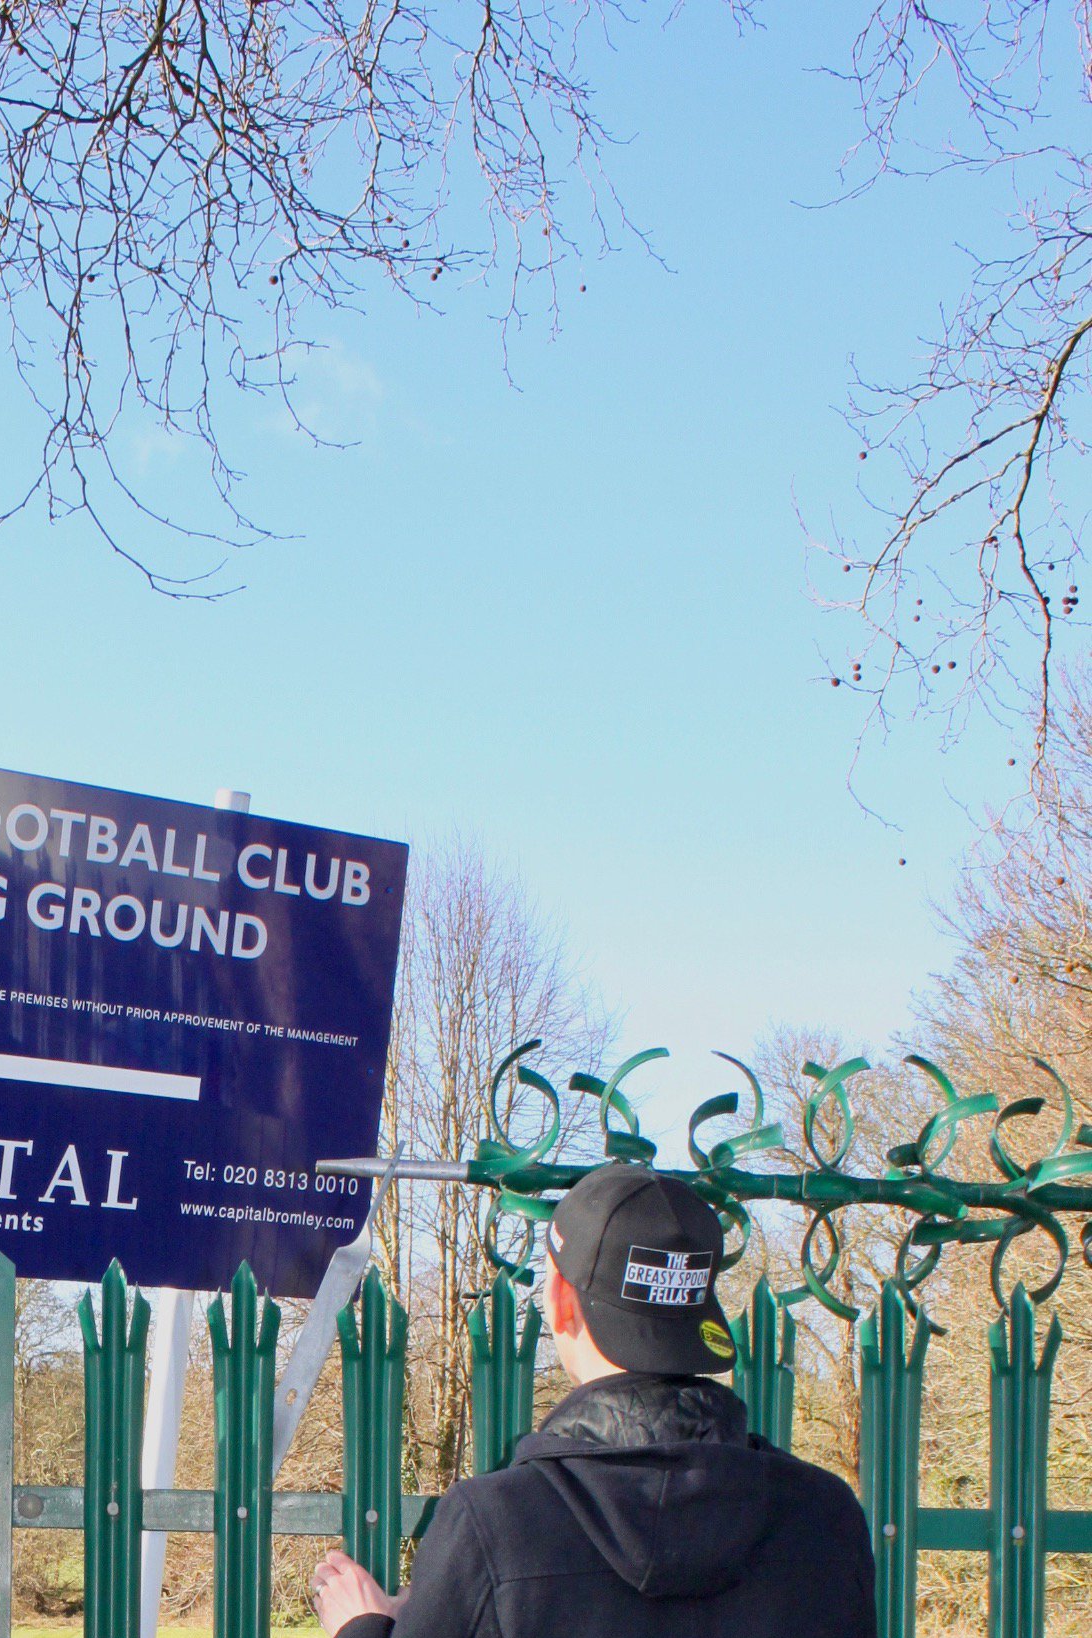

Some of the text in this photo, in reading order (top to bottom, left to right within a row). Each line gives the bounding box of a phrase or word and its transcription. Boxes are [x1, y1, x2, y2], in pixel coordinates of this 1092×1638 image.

[237, 844, 371, 906] CLUB
[27, 882, 268, 959] GROUND
[10, 991, 68, 1009] PREMISES
[72, 999, 123, 1016] WITHOUT
[126, 1006, 160, 1021] PRIOR
[163, 1010, 243, 1032] APPROVEMENT
[247, 1022, 261, 1034] OF
[264, 1025, 284, 1037] THE
[287, 1028, 359, 1047] MANAGEMENT
[184, 1160, 359, 1196] Tel: 020 8313 0010
[180, 1202, 355, 1230] www.capitalbromley.com
[627, 1265, 708, 1287] GREASY SPOON
[667, 1253, 689, 1269] THE
[649, 1288, 689, 1304] FELLAS
